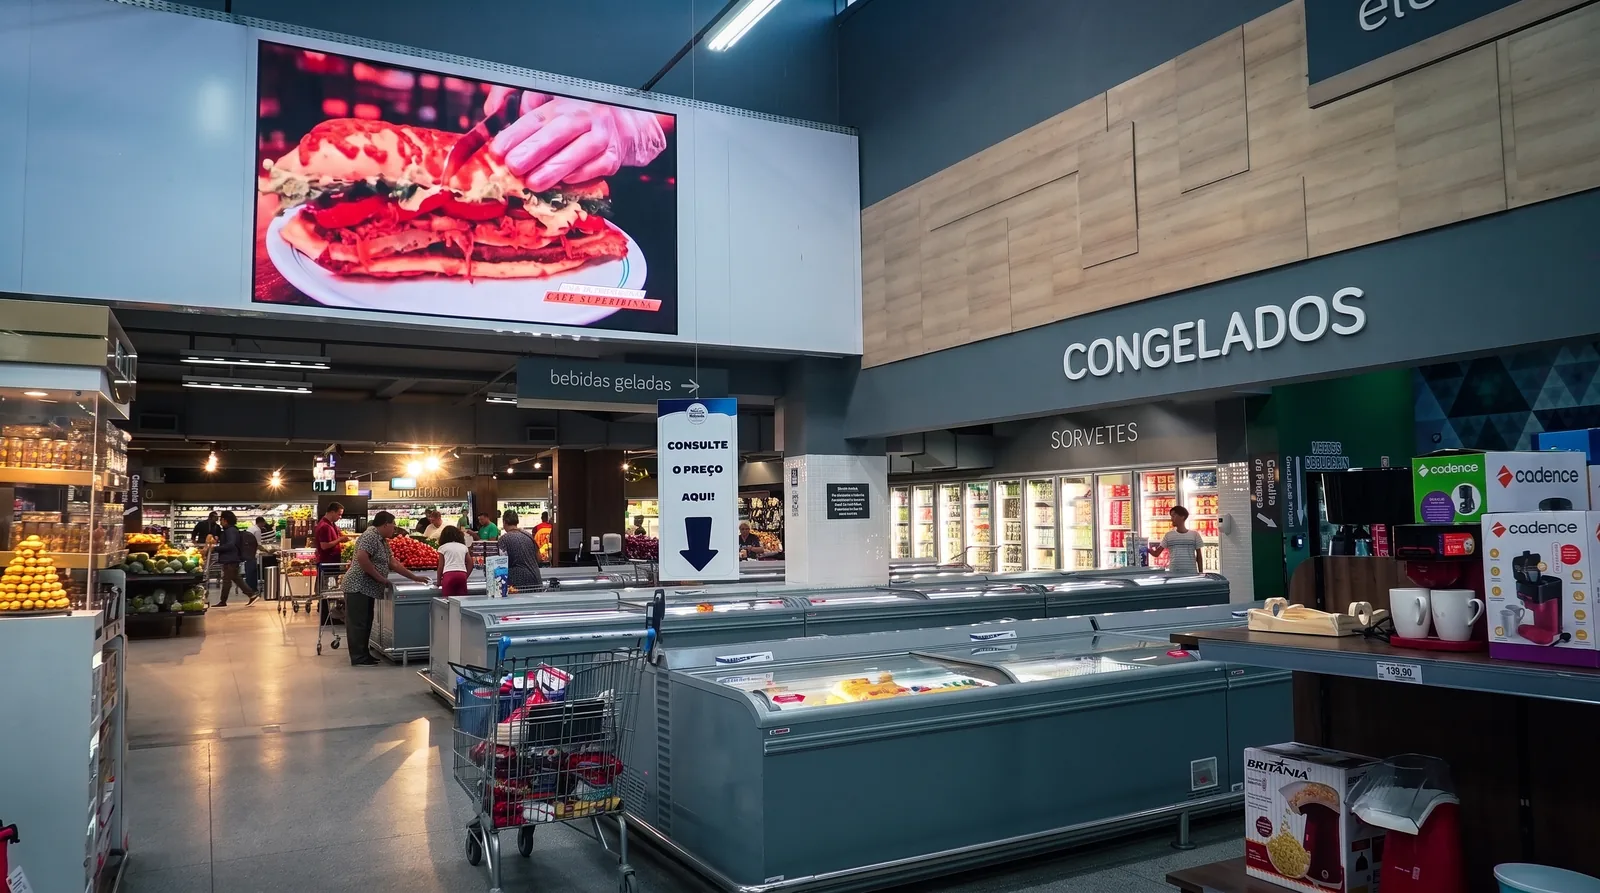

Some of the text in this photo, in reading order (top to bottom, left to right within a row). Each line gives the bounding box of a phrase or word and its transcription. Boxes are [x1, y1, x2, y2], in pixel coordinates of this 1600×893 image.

[1063, 286, 1367, 380] CONGELADOS
[550, 368, 672, 393] bebidas geladas
[1050, 422, 1138, 450] SORVETES
[667, 440, 729, 450] CONSULTE
[672, 464, 724, 477] O PREÇO
[1430, 463, 1478, 474] cadence
[1515, 466, 1579, 483] cadence
[681, 492, 715, 502] AQUI!
[1508, 520, 1578, 534] cadence
[1385, 666, 1412, 677] 139,90
